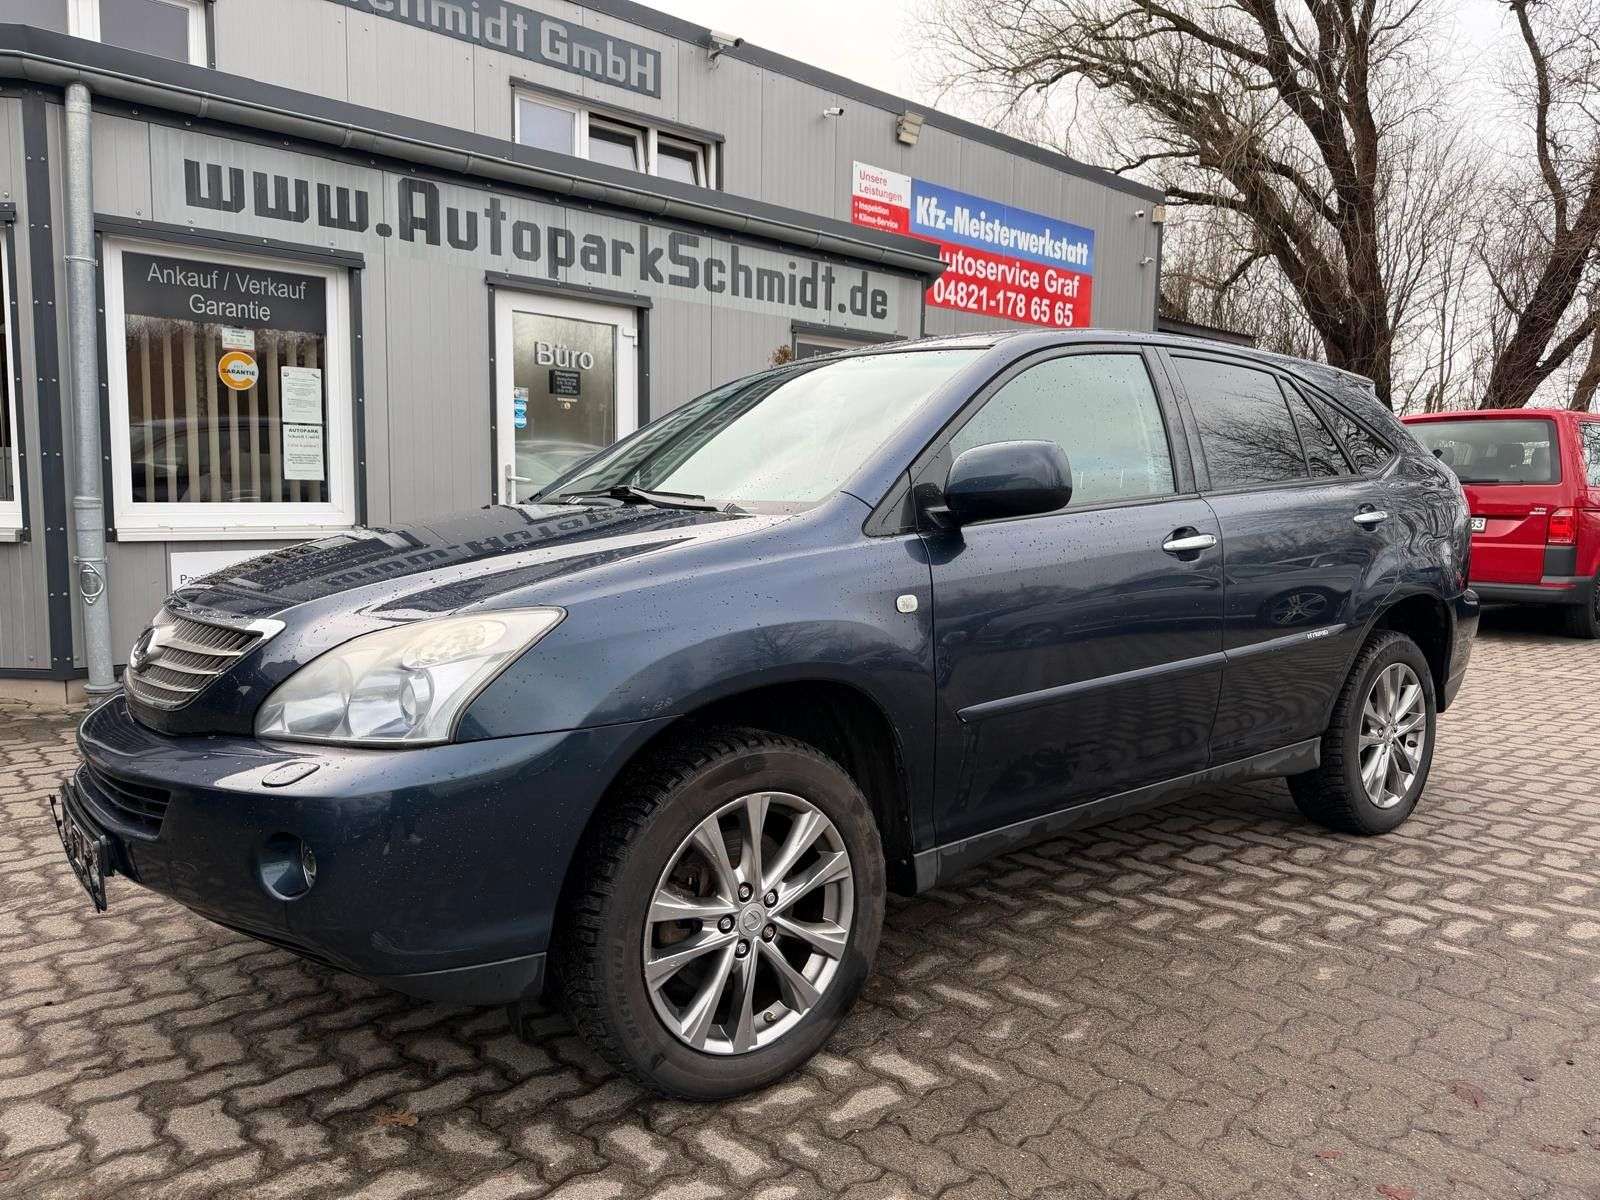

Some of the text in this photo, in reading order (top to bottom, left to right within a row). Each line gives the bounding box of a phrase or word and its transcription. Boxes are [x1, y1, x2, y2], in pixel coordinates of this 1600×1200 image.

[540, 19, 655, 92] GmbH
[860, 169, 888, 186] Unsere
[860, 183, 903, 202] Leistungen
[184, 159, 888, 319] www.AutoparkSchmidt.de
[916, 195, 1089, 266] Kfz-Meisterwerkstatt
[147, 262, 308, 300] Ankauf / Verkauf
[939, 249, 1081, 298] utoservice Graf
[189, 294, 271, 322] Garantie
[933, 277, 1074, 327] 04821-178 65 65
[535, 341, 594, 370] Büro
